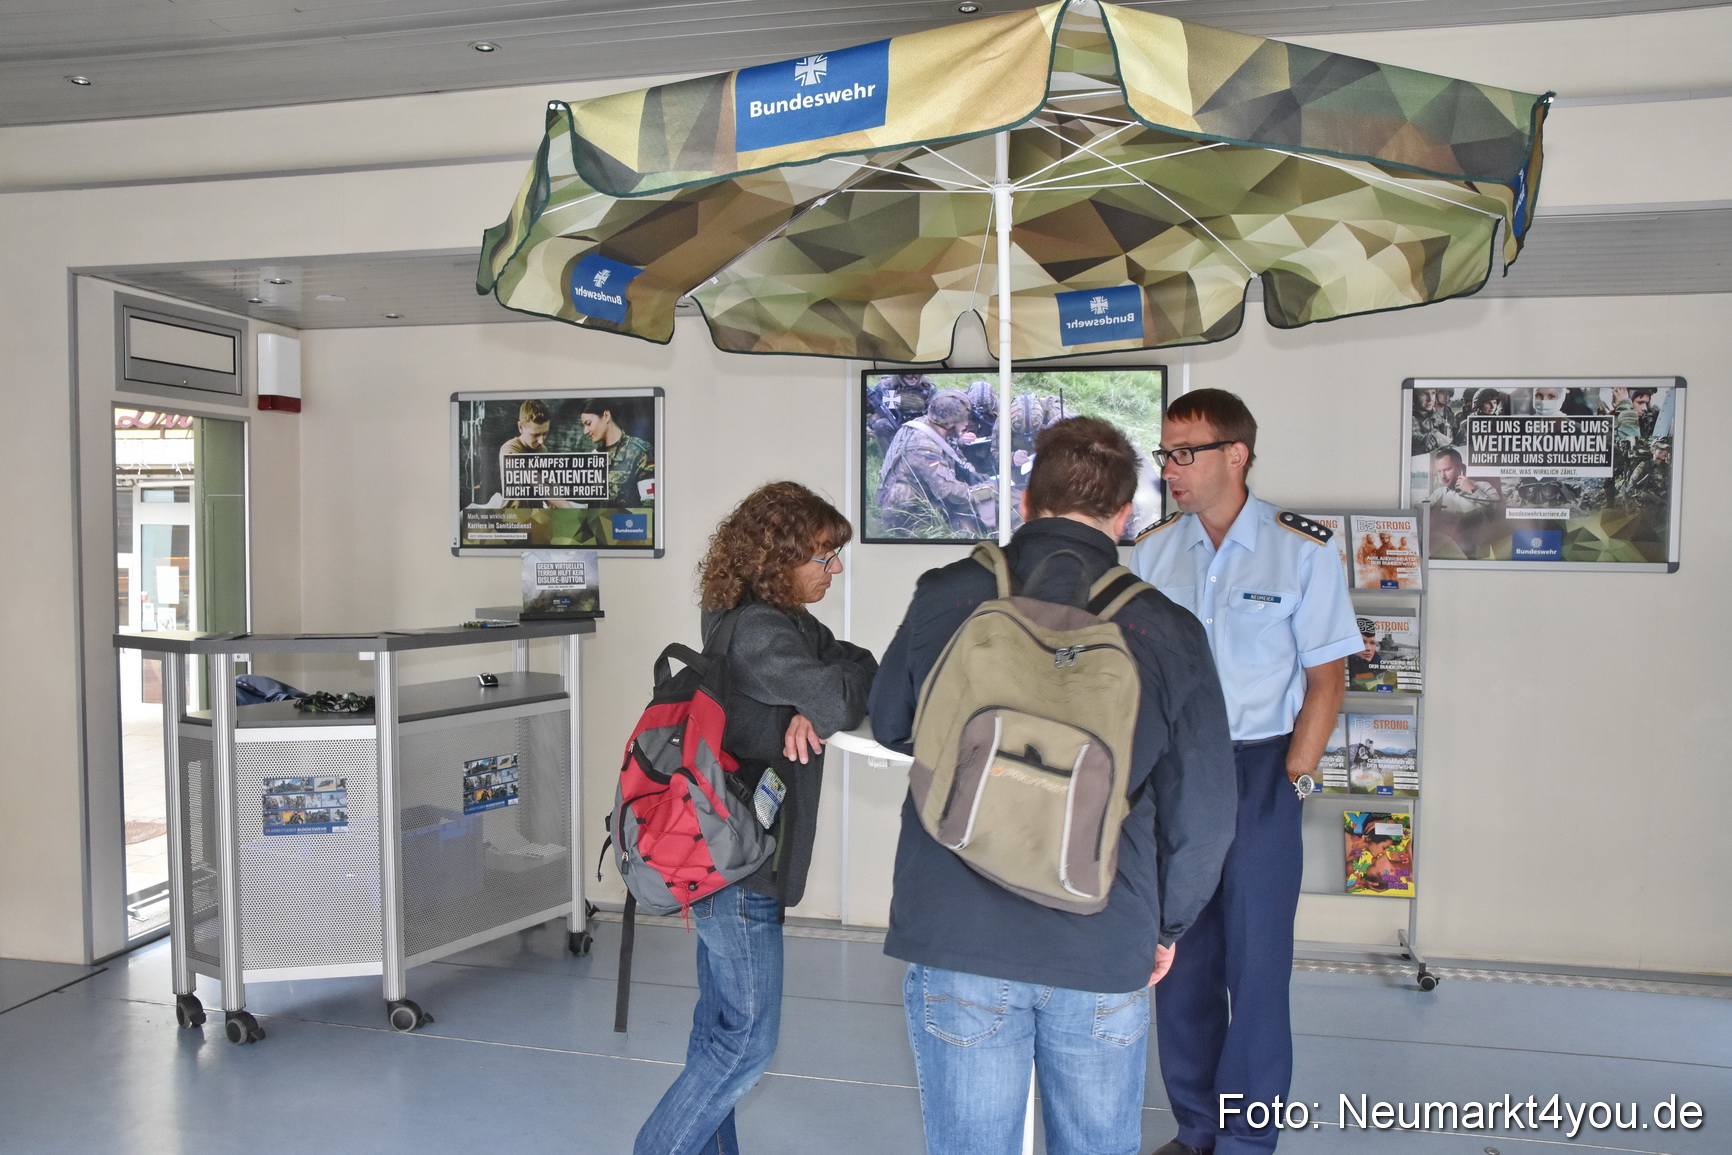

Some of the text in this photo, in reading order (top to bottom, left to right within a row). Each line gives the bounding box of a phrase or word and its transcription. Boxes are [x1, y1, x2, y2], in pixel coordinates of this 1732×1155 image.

[750, 83, 876, 118] Bundeswehr
[1472, 420, 1609, 433] BEI UNS GEHT ES UMS
[1472, 435, 1609, 452] WEITERKOMMEN.
[505, 455, 605, 469] HIER KÄMPFST DU FÜR
[1471, 453, 1609, 464] NICHT NUR UMS STILLSTEHEN.
[505, 469, 605, 484] DEINE PATIENTEN.
[1560, 467, 1578, 475] ZÄHLT.
[505, 484, 606, 497] NICHT FÜR DEN PROFIT.
[1376, 520, 1411, 530] STRONG
[537, 576, 585, 584] DISLIKE-BUTTON.
[1375, 620, 1410, 631] STRONG
[1373, 719, 1409, 730] STRONG
